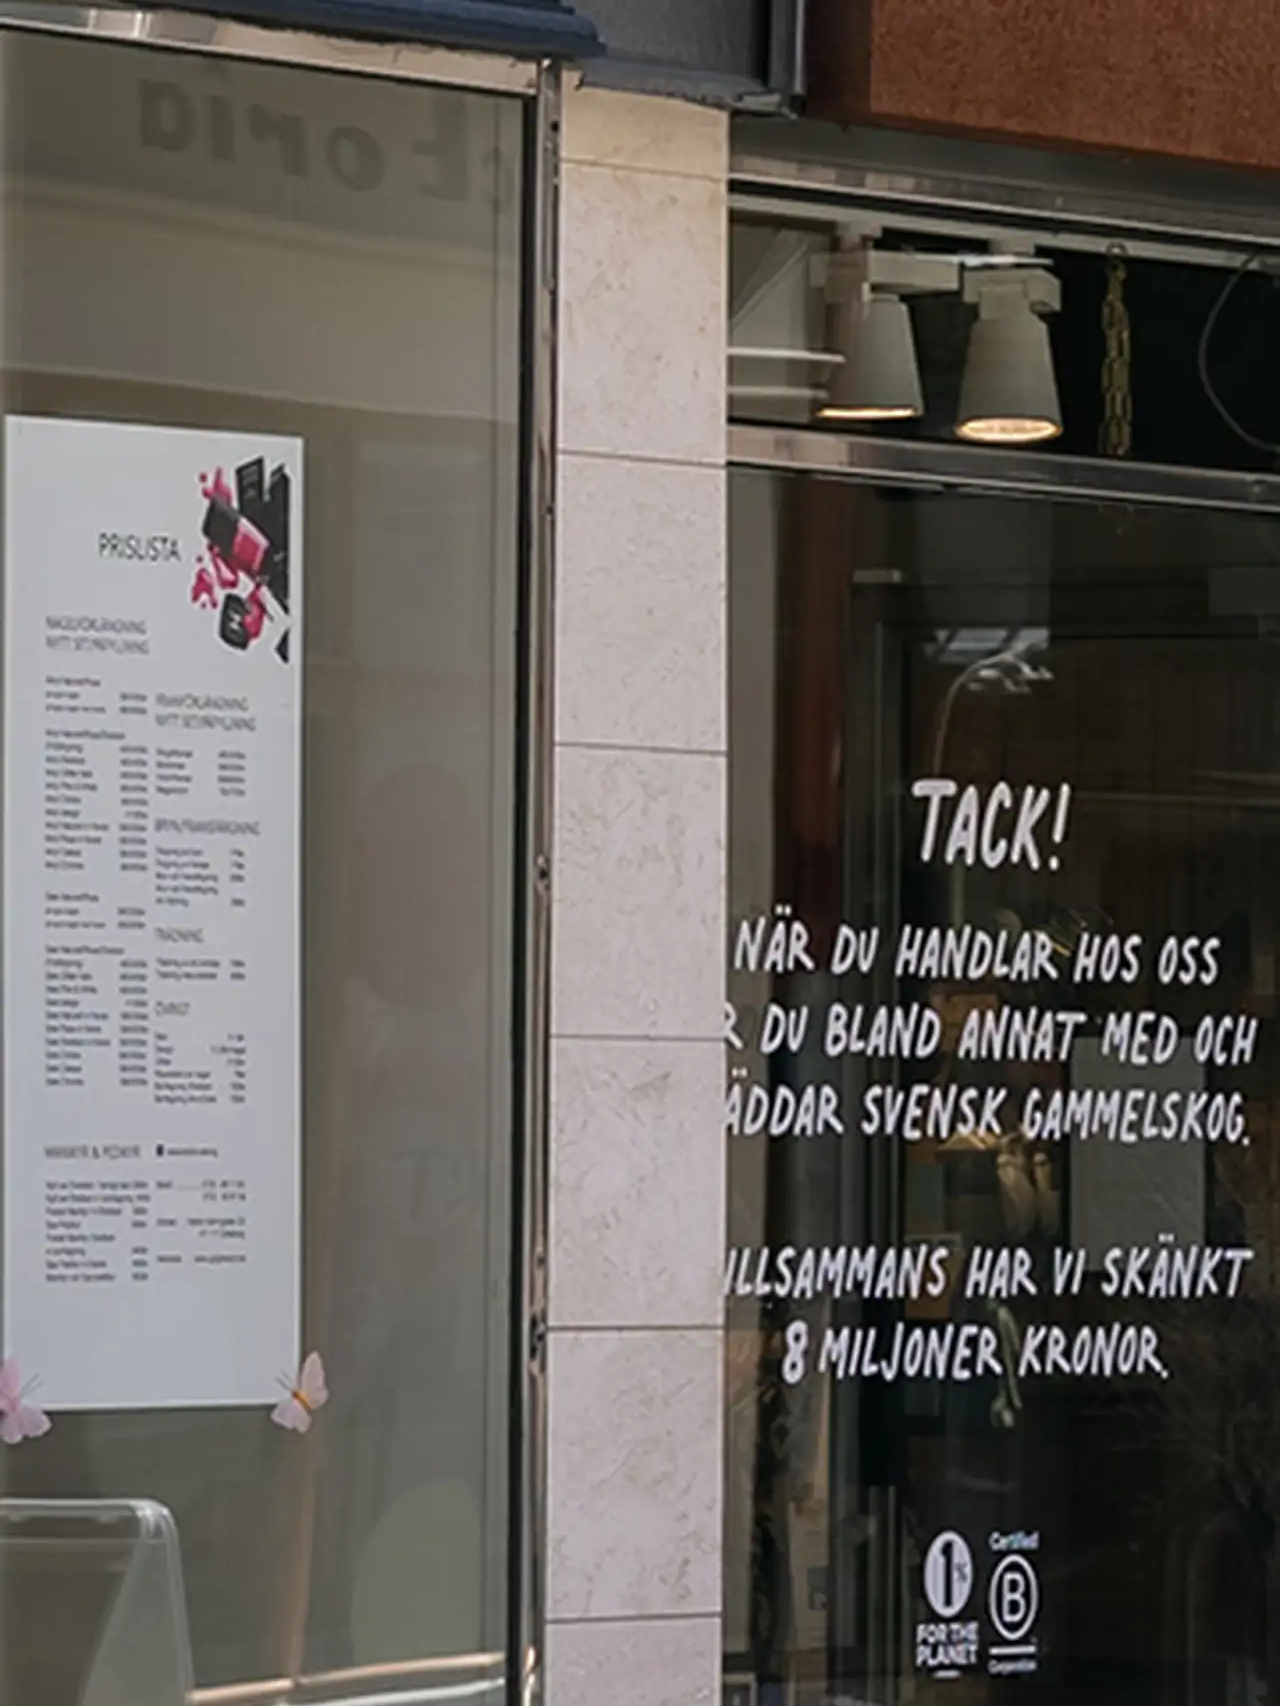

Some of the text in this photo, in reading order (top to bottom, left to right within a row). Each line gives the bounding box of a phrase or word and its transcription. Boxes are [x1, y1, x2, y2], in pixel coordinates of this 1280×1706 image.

[98, 532, 181, 563] PRISLISTA
[911, 778, 1071, 871] TACK!
[734, 904, 1221, 985] NÄR DU HANDLAR HOS OSS
[760, 1003, 809, 1055] DU
[825, 1001, 942, 1059] BLAND
[957, 1006, 1088, 1062] ANNAT
[1101, 1010, 1179, 1065] MED
[1194, 1014, 1258, 1066] OCH
[724, 1066, 1251, 1147] ÄDDAR SVENSK GAMMELSKOG.
[724, 1232, 1255, 1300] ILLSAMMANS HAR VI SKÄNKT
[782, 1319, 1169, 1385] 8 MILJONER KRONOR.
[916, 1621, 979, 1643] FOR THE
[916, 1643, 977, 1666] PLANET
